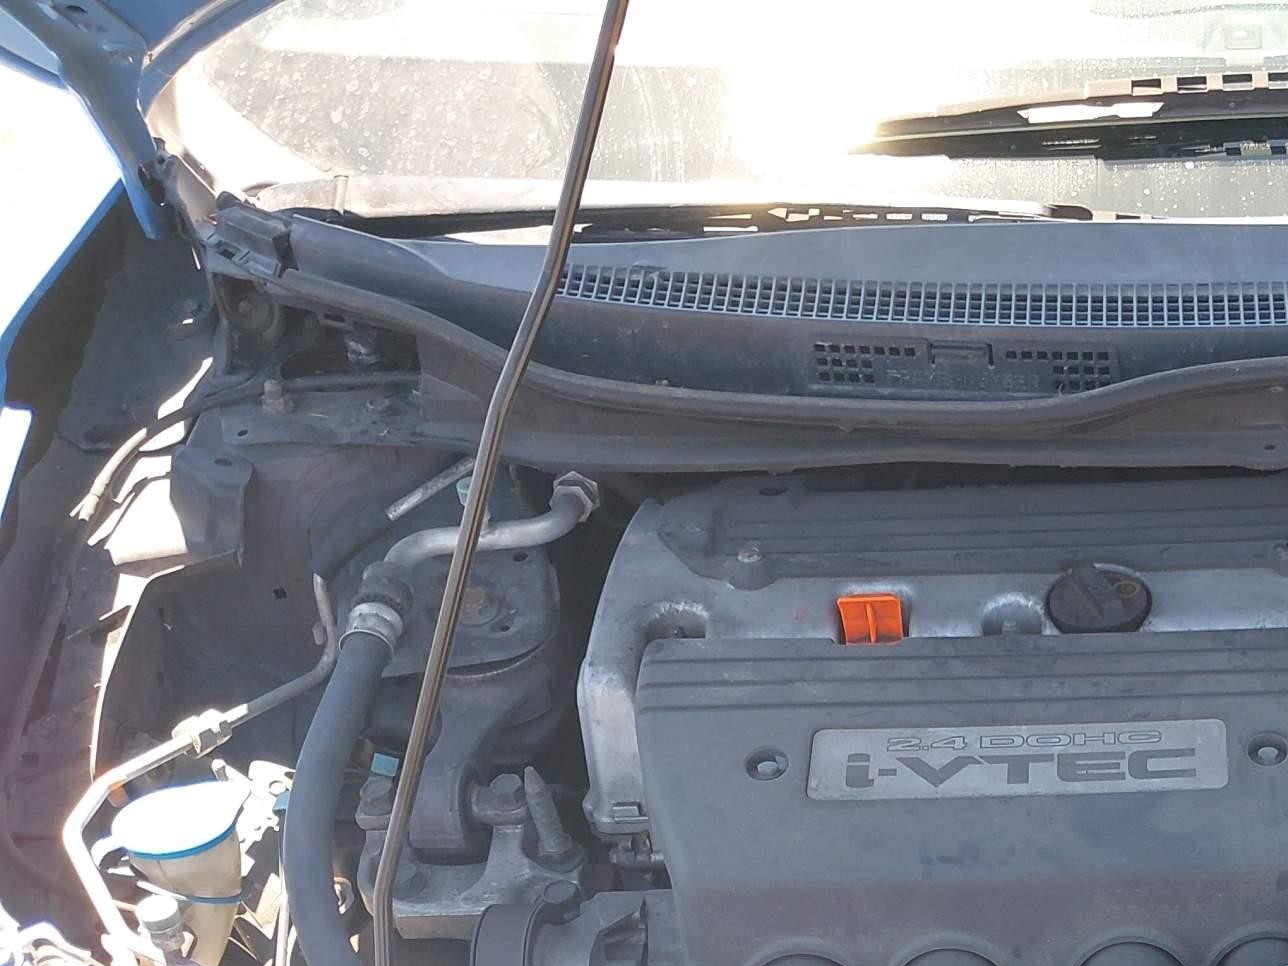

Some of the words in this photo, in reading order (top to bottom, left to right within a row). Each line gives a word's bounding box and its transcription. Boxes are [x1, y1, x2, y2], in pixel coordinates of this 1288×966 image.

[886, 736, 968, 752] 2.4
[980, 730, 1162, 749] DOHC
[845, 748, 1197, 788] i-VTEC
